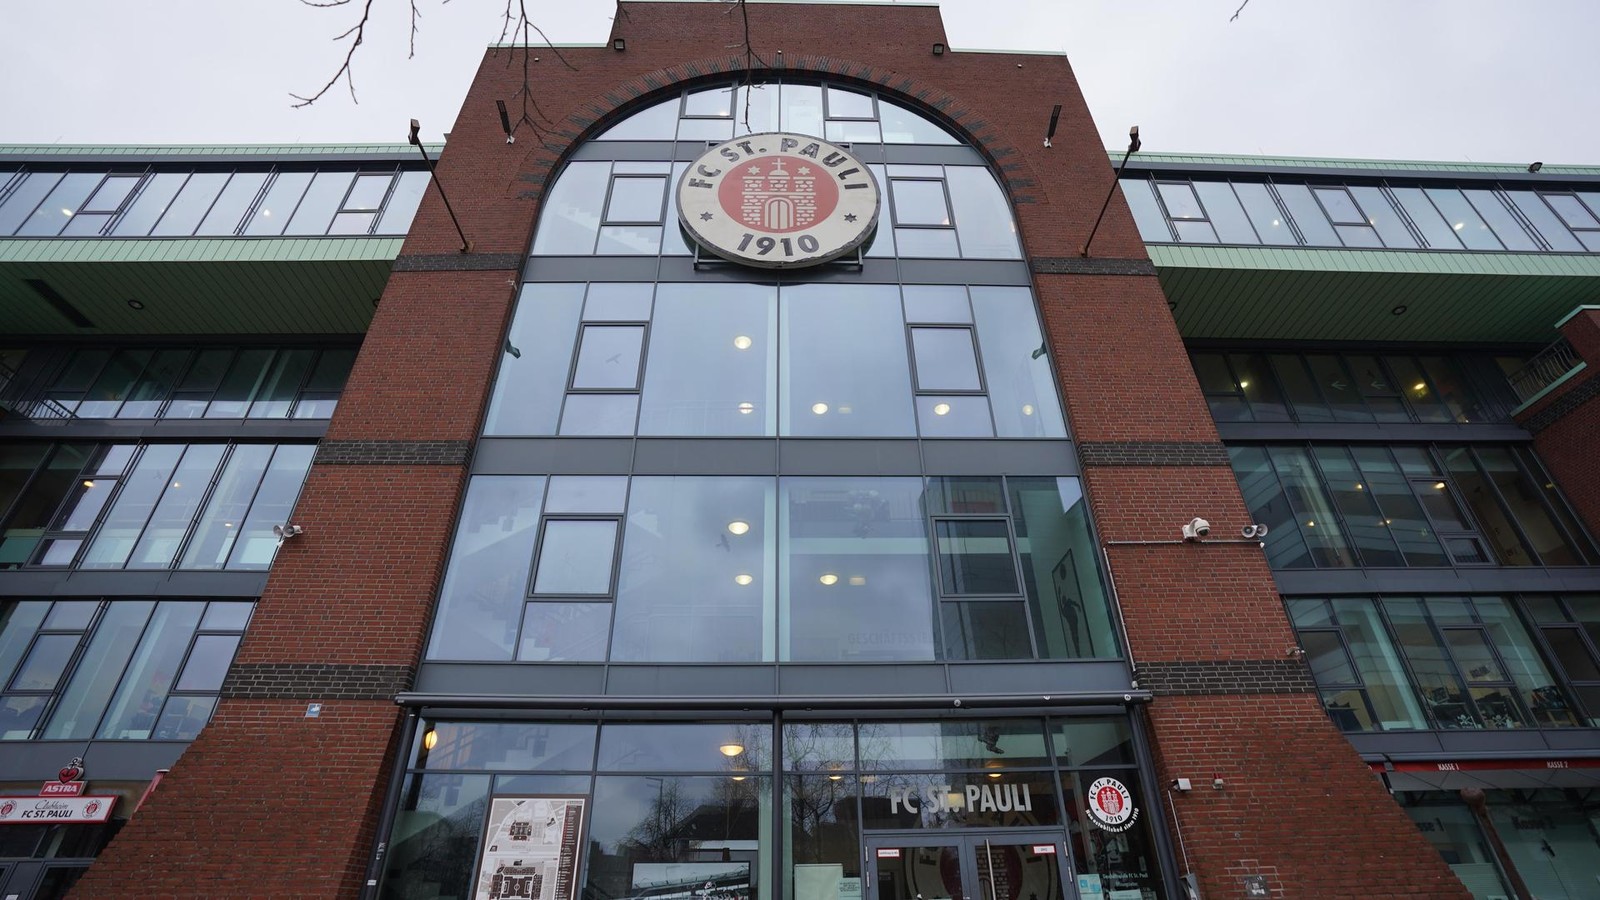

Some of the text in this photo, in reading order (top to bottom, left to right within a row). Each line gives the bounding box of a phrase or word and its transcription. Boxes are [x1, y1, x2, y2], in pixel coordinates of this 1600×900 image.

[688, 137, 869, 190] FC ST. PAULI
[736, 233, 820, 257] 1910
[1437, 763, 1459, 771] KASSE 1
[1546, 761, 1563, 769] KASSE
[1090, 779, 1129, 800] FC ST. PAULI
[890, 783, 1032, 814] FC ST. PAULI
[21, 810, 73, 818] FC ST. PAULI
[1105, 815, 1123, 823] 1910
